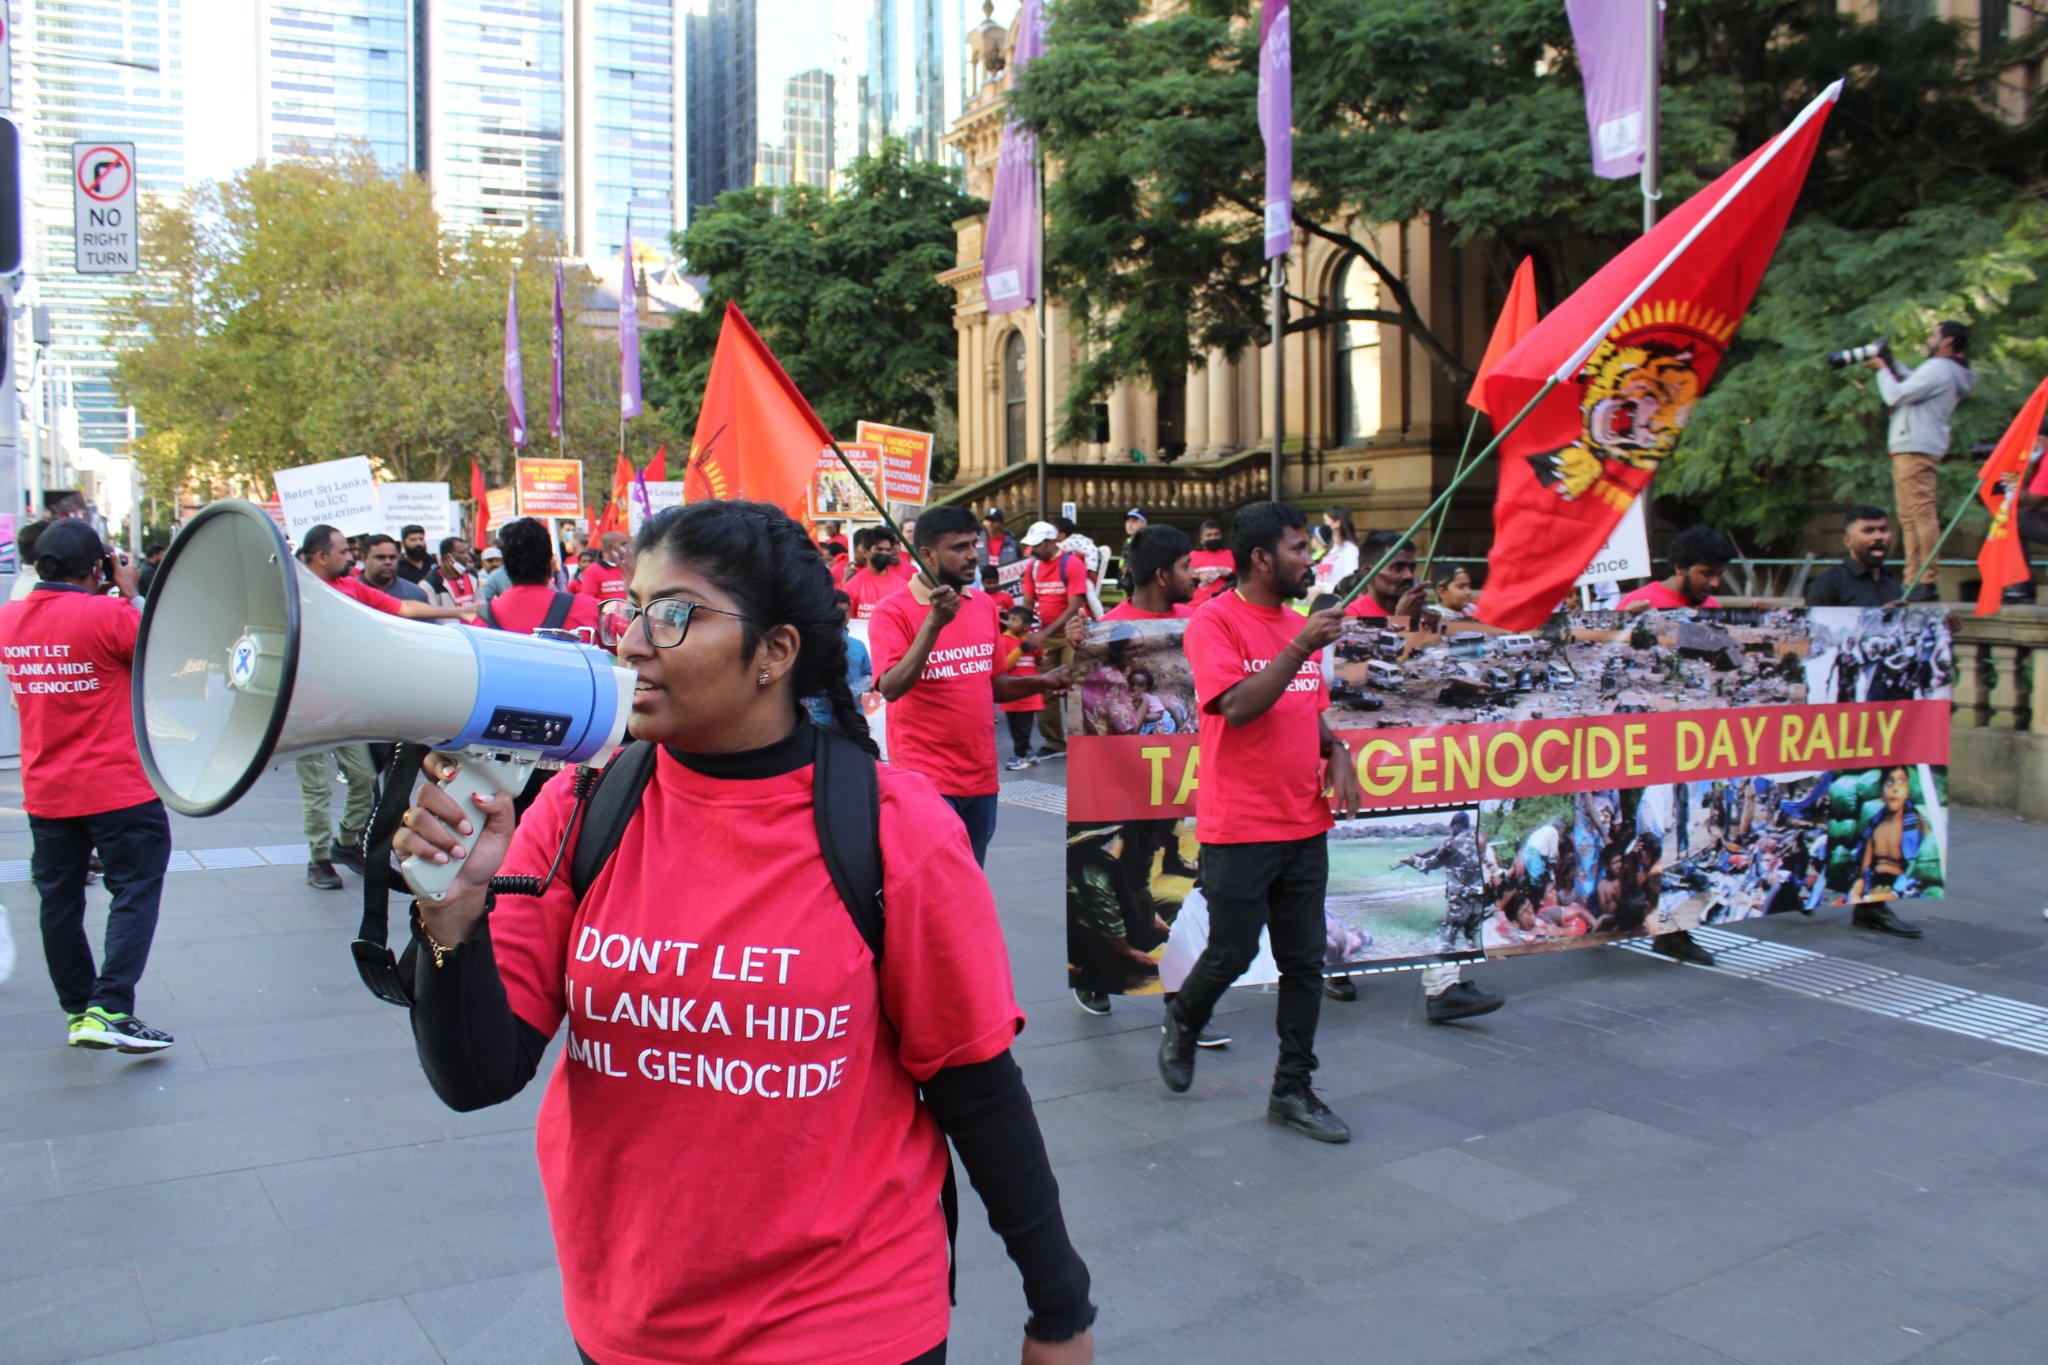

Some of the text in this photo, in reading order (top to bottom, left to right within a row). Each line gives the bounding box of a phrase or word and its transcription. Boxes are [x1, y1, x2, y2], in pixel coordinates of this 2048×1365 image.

[90, 208, 122, 227] NO
[83, 233, 129, 247] RIGHT
[86, 251, 129, 265] TURN
[843, 450, 868, 459] ANKA
[284, 478, 368, 500] Refer Sri Lanka
[314, 494, 348, 509] to ICC
[292, 516, 309, 527] for
[1580, 558, 1629, 575] ence
[4, 645, 71, 658] DON'T LET
[13, 663, 56, 676] LANKA
[57, 662, 94, 675] HIDE
[29, 677, 100, 694] GENOCIDE
[1356, 723, 1648, 797] GENOCIDE
[1676, 716, 1768, 772] DAY
[1780, 709, 1904, 763] RALLY
[575, 925, 801, 985] DON'T LET
[585, 987, 733, 1036] LANKA
[746, 1004, 851, 1042] HIDE
[637, 1048, 848, 1099] GENOCIDE
